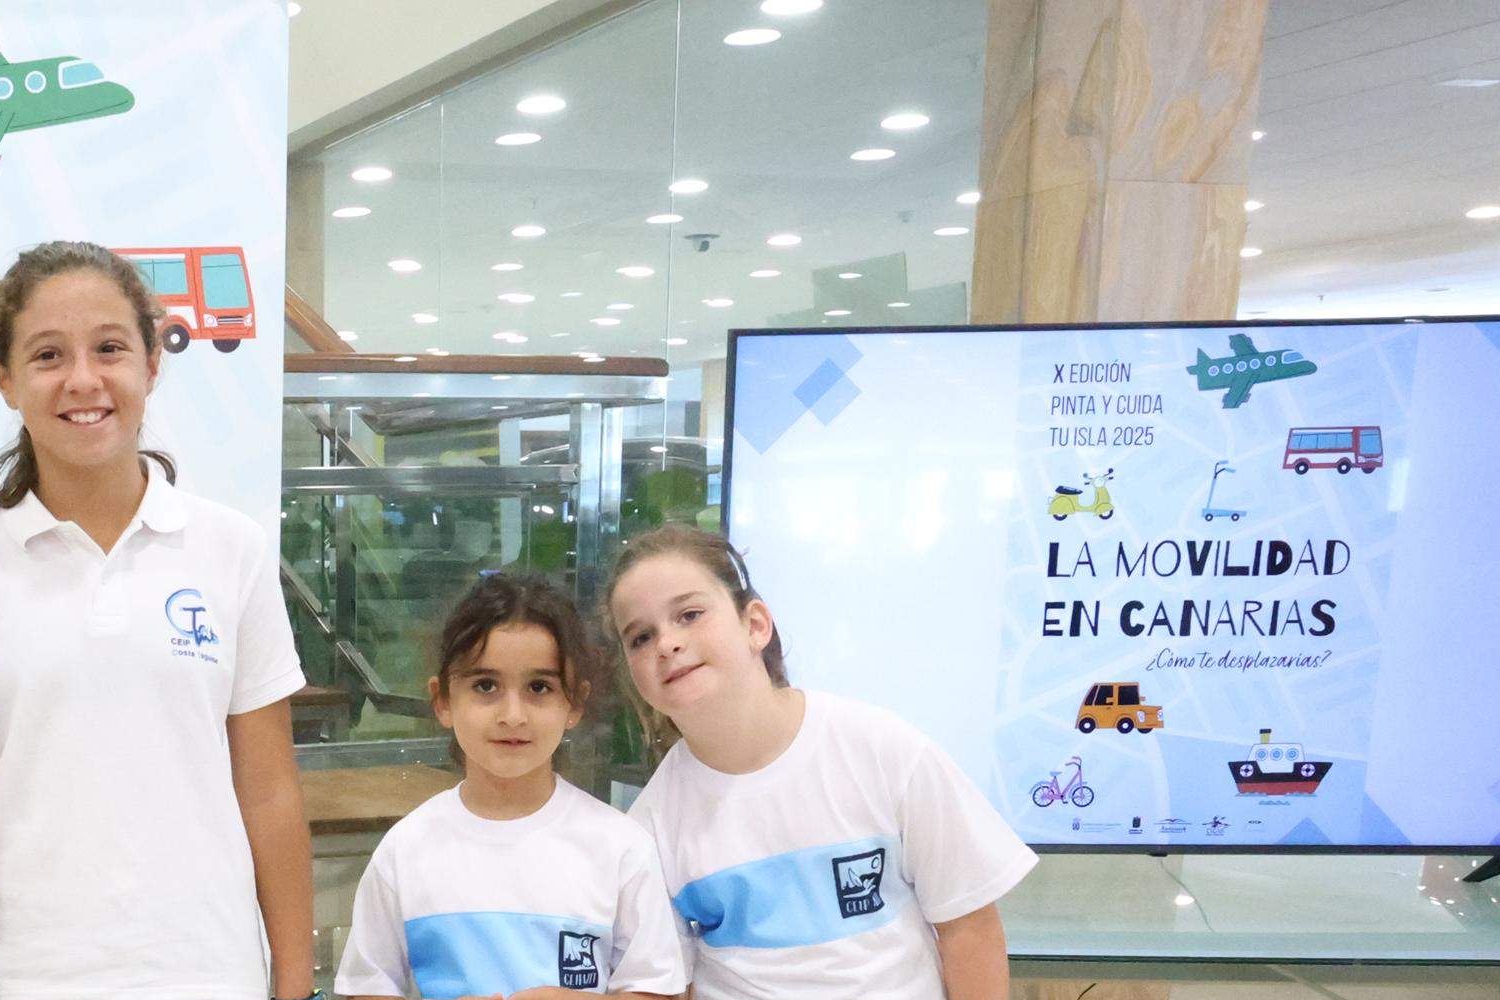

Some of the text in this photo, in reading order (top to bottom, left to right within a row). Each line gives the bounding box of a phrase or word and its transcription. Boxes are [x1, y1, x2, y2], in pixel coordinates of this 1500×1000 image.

[1053, 358, 1132, 383] X EDICIÓN
[1051, 394, 1163, 416] PINTA Y CUIDA
[1049, 426, 1155, 447] TU ISLA 2025
[1047, 539, 1351, 578] LA MOVILIDAD
[1042, 599, 1338, 638] EN CANARIAS
